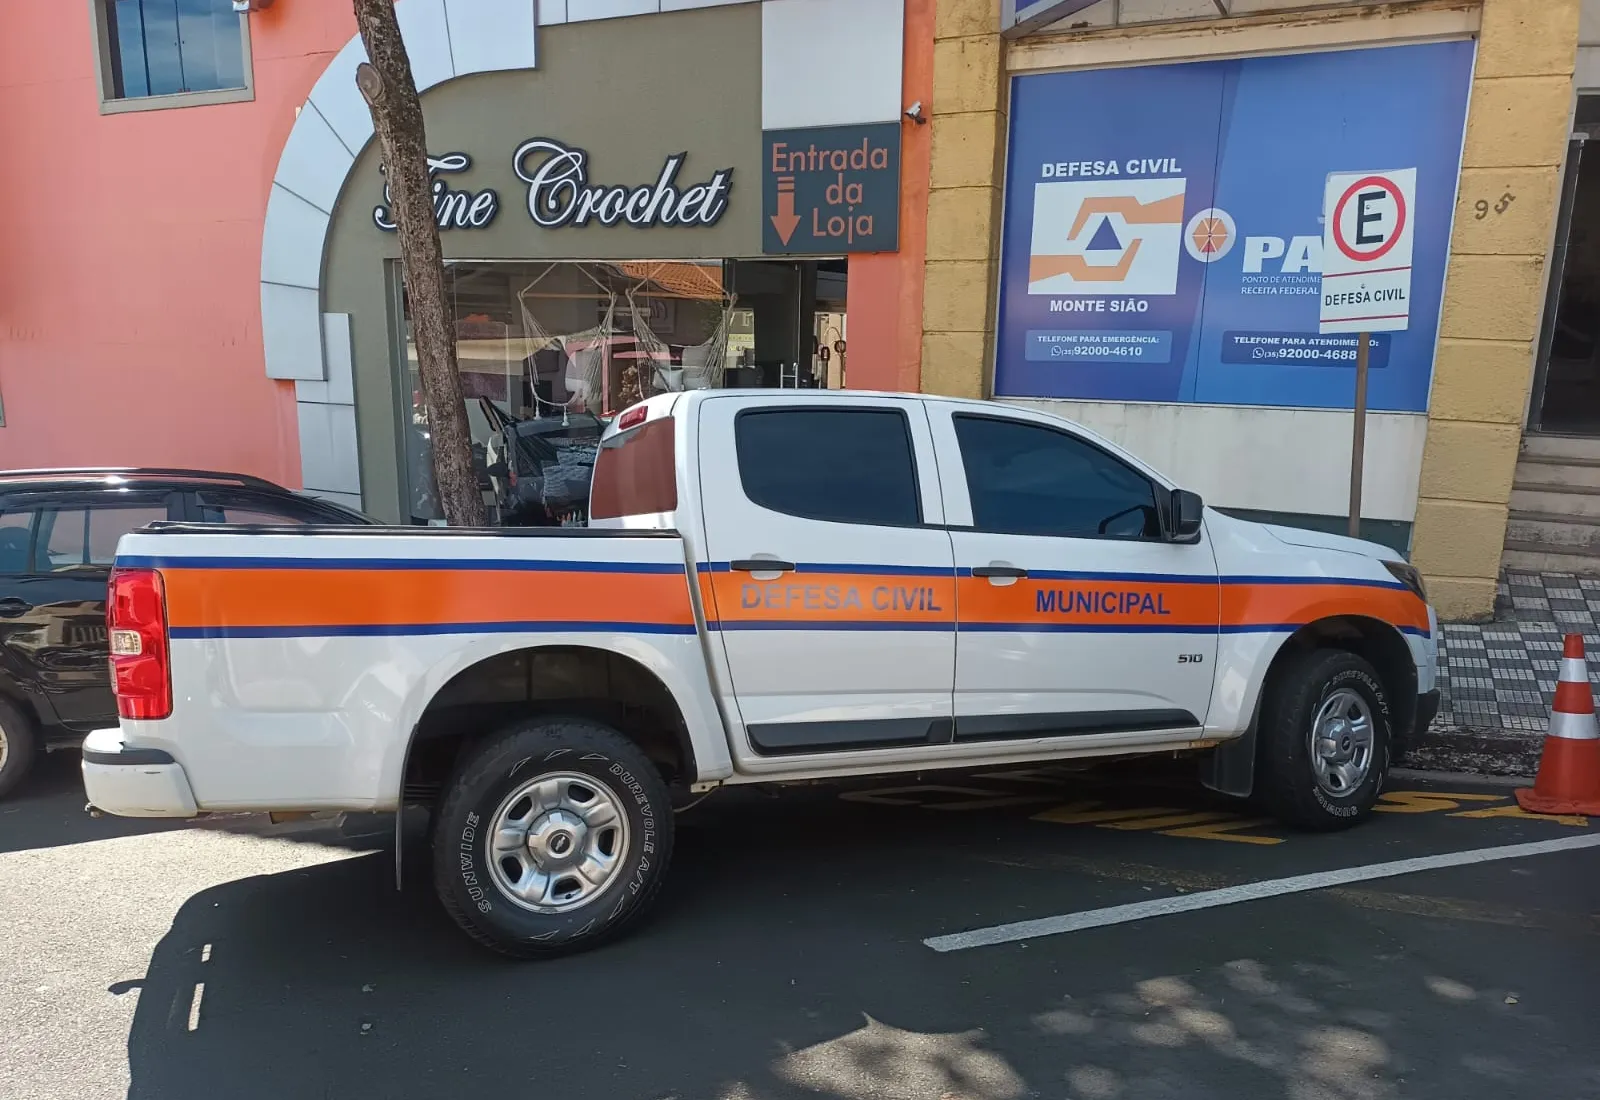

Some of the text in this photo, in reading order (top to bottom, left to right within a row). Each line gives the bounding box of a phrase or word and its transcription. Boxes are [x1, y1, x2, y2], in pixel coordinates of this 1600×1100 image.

[772, 137, 889, 173] Entrada
[1041, 158, 1182, 178] DEFESA CIVIL
[512, 136, 733, 229] Crochet
[826, 173, 863, 205] da
[812, 207, 874, 244] Loja
[1356, 190, 1386, 245] E
[1242, 235, 1324, 273] PA
[1241, 286, 1319, 295] RECEITA FEDERAL
[1242, 276, 1322, 284] PONTO DE ATENDIME
[1050, 298, 1149, 313] MONTE SIÃO
[1325, 288, 1406, 306] DEFESA CIVIL
[1037, 335, 1077, 343] TELEFONE
[1079, 335, 1101, 343] PARA
[1234, 336, 1379, 347] TELEFONE PARA ATENDIMEO:
[740, 583, 1171, 615] DEFESA CIVIL MUNICIPAL
[609, 762, 655, 854] DUREVOLE
[460, 811, 492, 914] SUNWIDE
